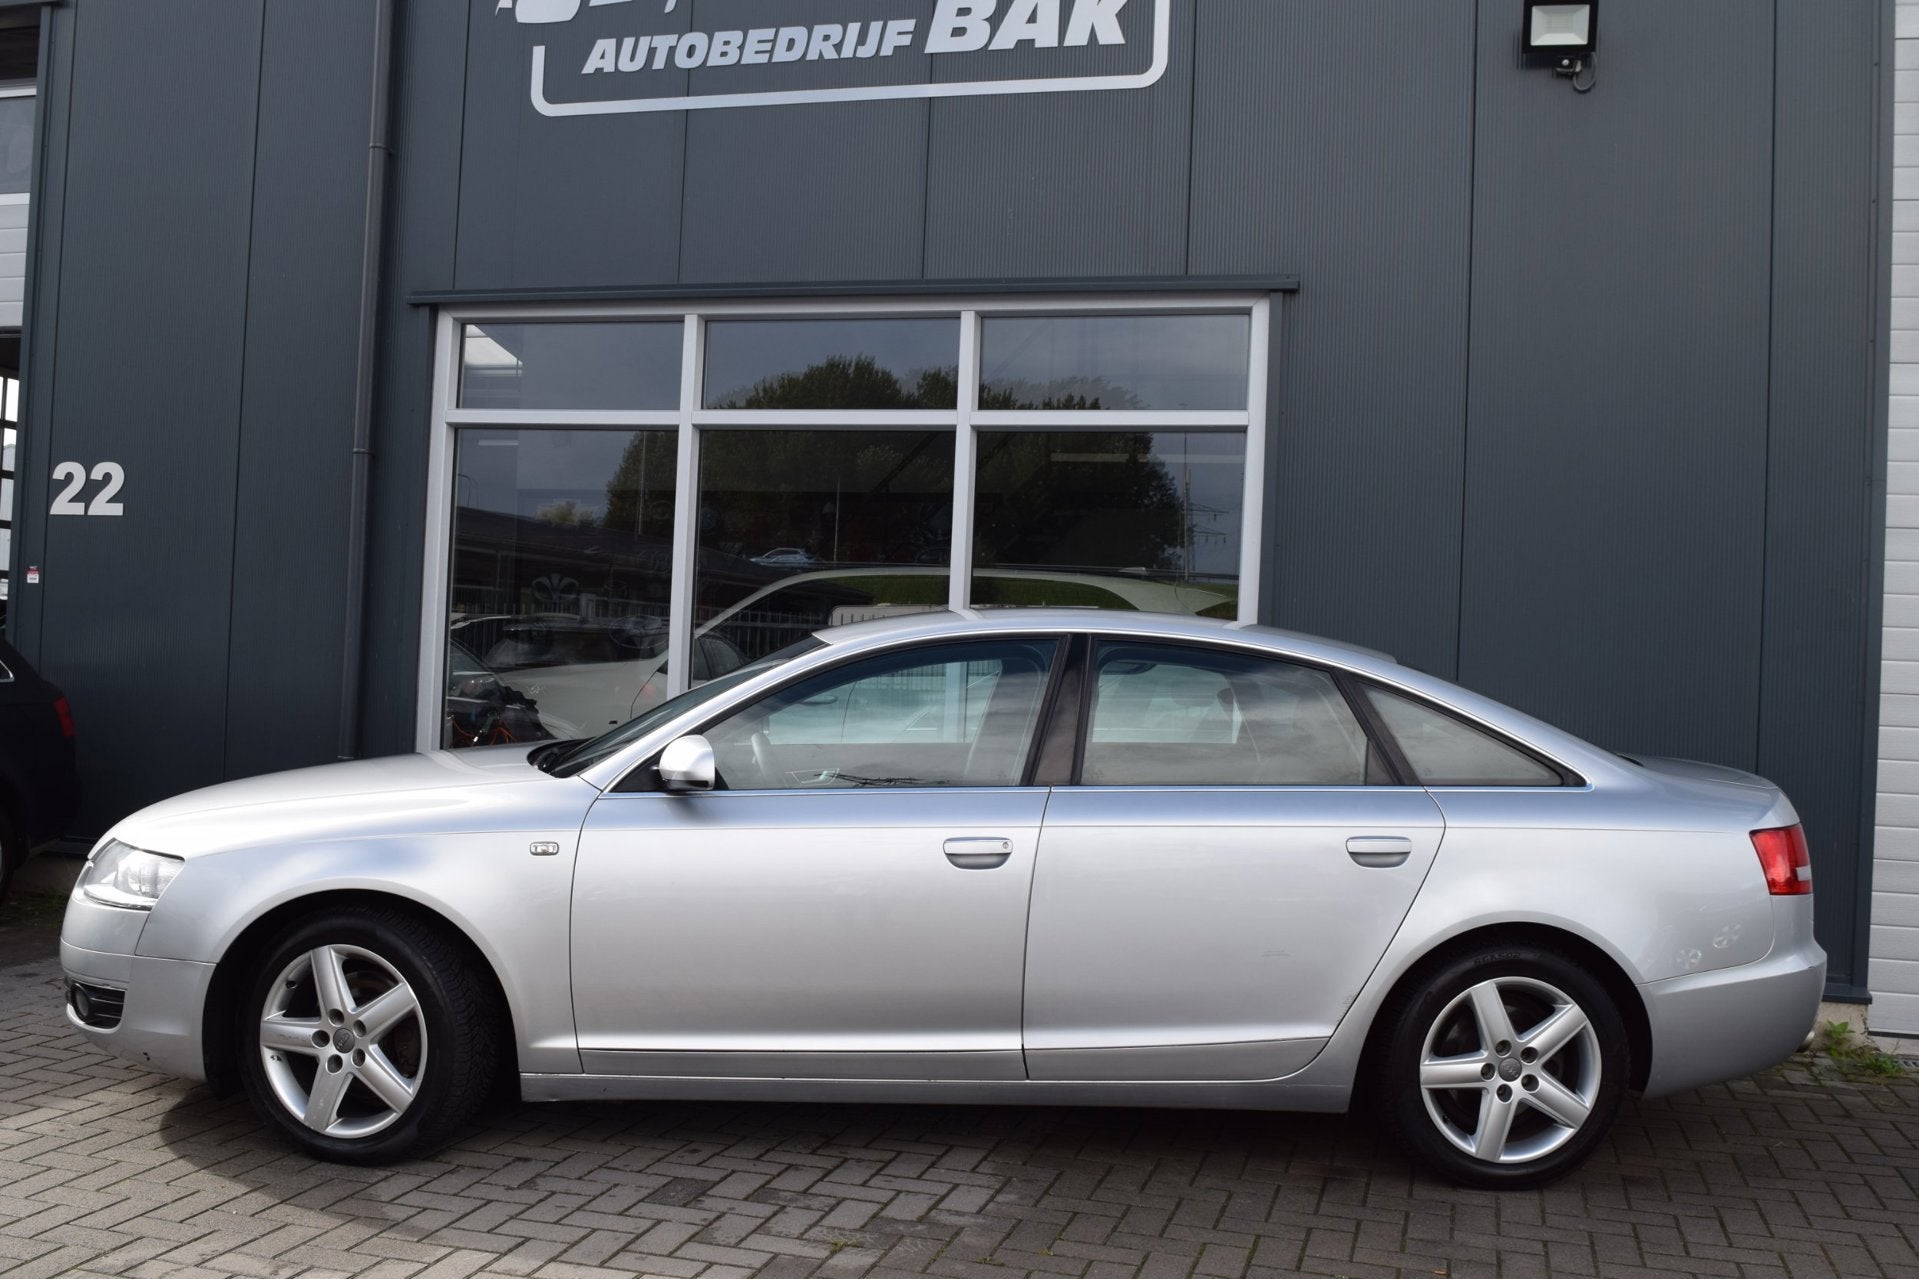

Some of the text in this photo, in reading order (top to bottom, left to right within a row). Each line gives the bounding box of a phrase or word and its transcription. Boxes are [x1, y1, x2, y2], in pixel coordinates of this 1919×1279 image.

[581, 0, 1127, 74] AUTOBEDRIJF BAK
[49, 461, 125, 516] 22
